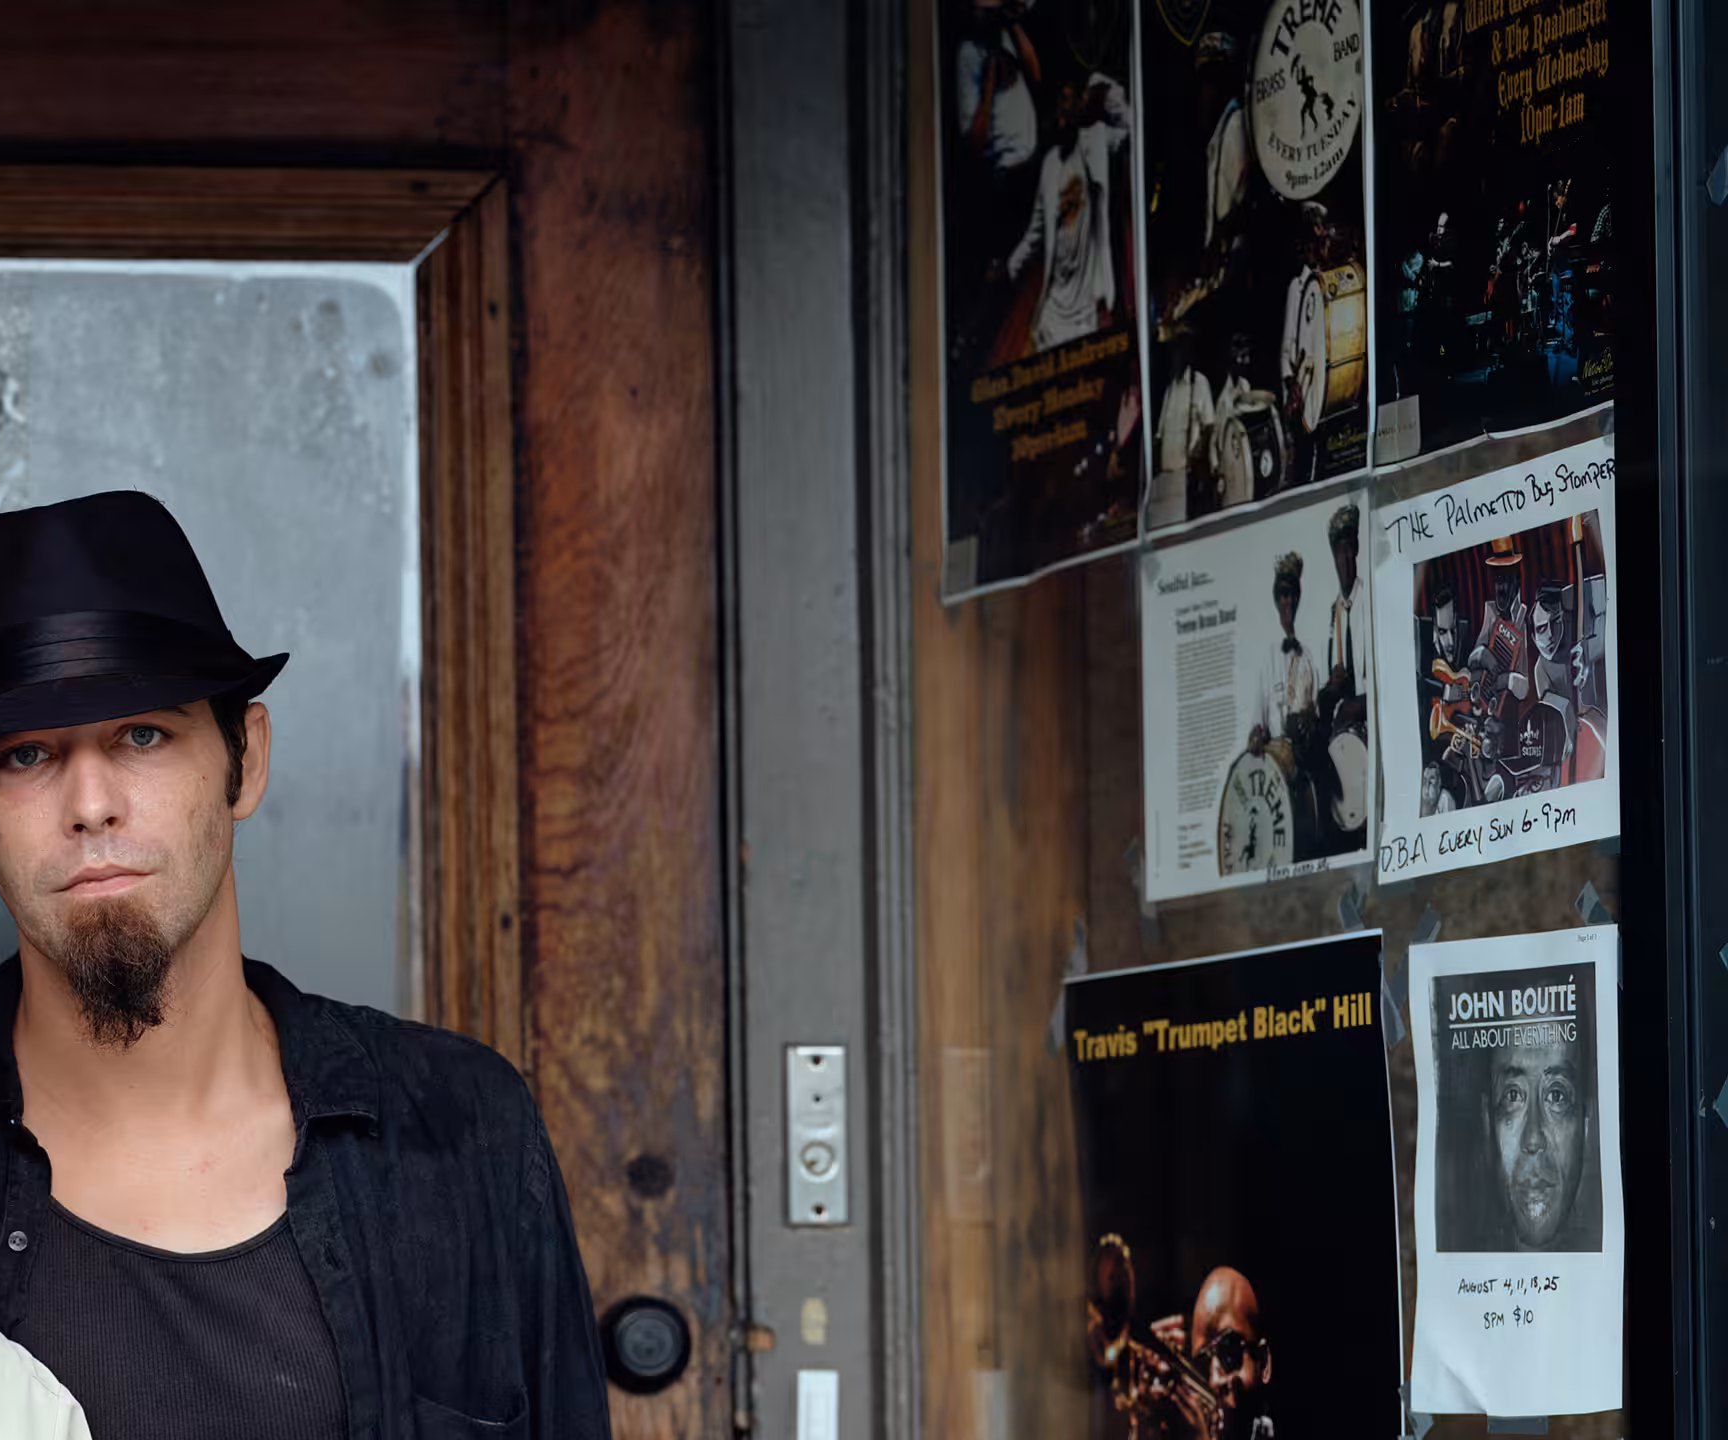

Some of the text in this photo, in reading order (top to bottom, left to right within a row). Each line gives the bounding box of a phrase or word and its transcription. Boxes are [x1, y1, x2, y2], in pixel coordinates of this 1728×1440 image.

[1491, 29, 1503, 66] &
[1504, 17, 1530, 63] The
[1256, 33, 1360, 103] BRASS BAND
[1497, 32, 1610, 112] Every Wednesday
[1520, 91, 1586, 146] 10pm-1am
[1268, 132, 1302, 162] EVERY
[1285, 148, 1344, 190] 9pm-12am
[1384, 512, 1434, 553] THE
[1438, 826, 1483, 855] EVERY
[1448, 974, 1577, 1022] JOHN BOUTTÉ
[1073, 991, 1373, 1063] Travis "Trumpet Black" Hill
[1451, 1022, 1577, 1050] ALL ABOUT EVERYTHING
[1512, 1305, 1534, 1328] $10
